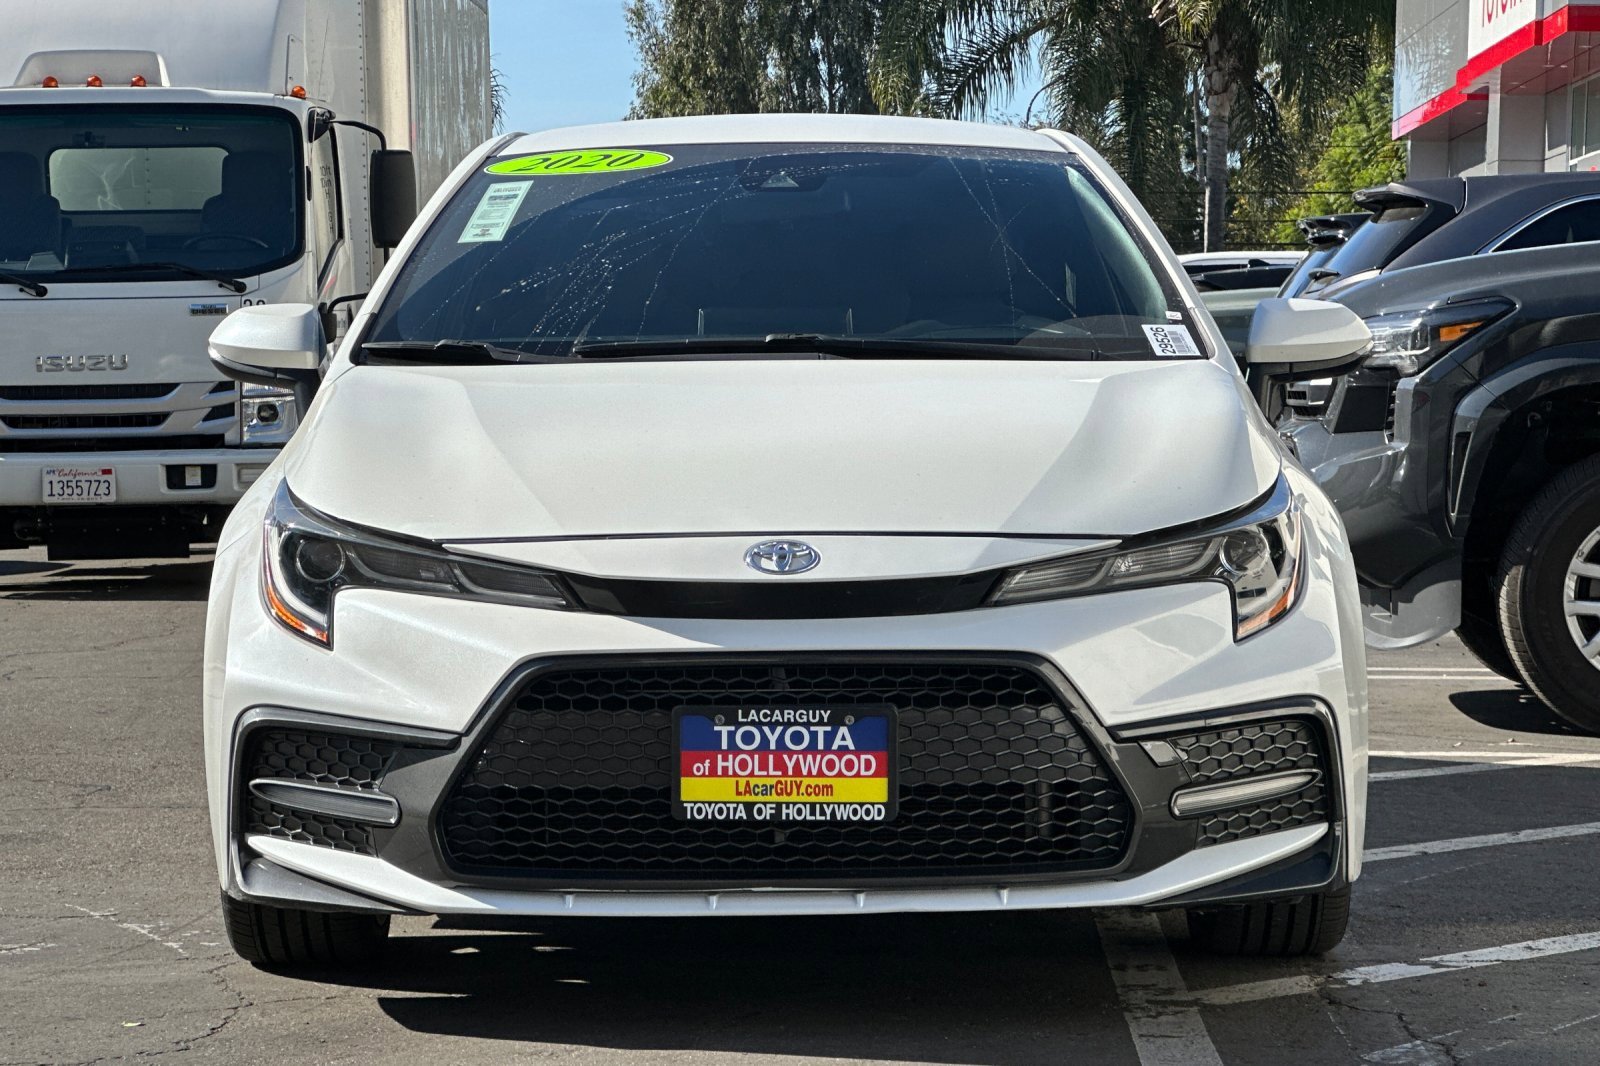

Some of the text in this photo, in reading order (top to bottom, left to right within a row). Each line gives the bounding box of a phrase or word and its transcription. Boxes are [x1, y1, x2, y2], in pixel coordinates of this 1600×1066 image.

[511, 153, 645, 172] 2020
[1150, 327, 1177, 355] 29526
[36, 354, 128, 373] ISUZU
[738, 709, 831, 723] LACARGUY
[714, 726, 856, 750] TOYOTA
[692, 754, 877, 776] of HOLLYWOOD
[735, 780, 834, 797] LAcarGUY.com
[683, 803, 886, 821] TOYOTA OF HOLLYWOOD
